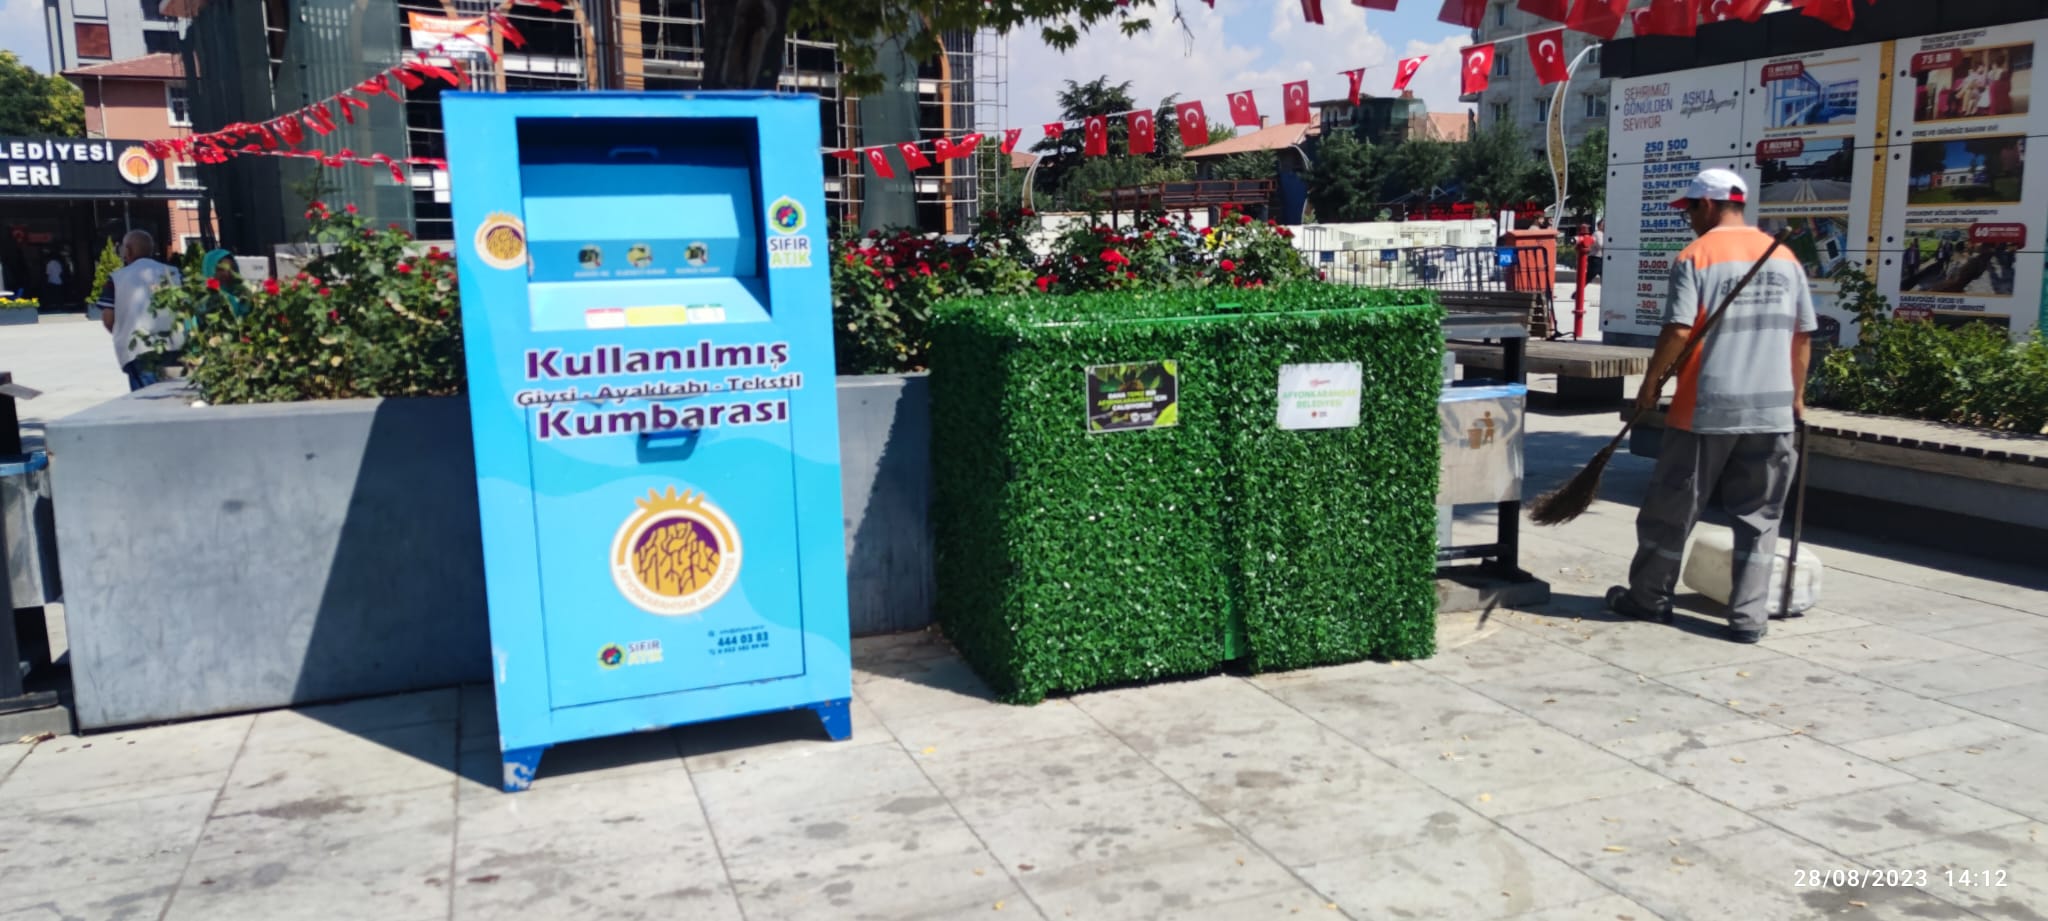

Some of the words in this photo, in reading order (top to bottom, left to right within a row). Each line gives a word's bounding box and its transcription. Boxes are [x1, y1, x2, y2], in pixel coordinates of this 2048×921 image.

[1922, 55, 1934, 64] 75
[1624, 99, 1673, 116] GÖNÜLDEN
[1645, 141, 1664, 153] 250
[1667, 138, 1688, 150] 500
[1671, 161, 1700, 172] METRE
[1671, 179, 1693, 188] MET
[769, 238, 809, 251] SIFIR
[770, 251, 810, 266] ATIK
[1638, 260, 1668, 269] 30.000
[1637, 283, 1653, 292] 190
[526, 341, 788, 379] Kullanılmış
[518, 388, 577, 409] Giysi
[598, 381, 709, 403] Ayakkabı
[726, 373, 801, 392] Tekstil
[538, 400, 788, 439] Kumbarası
[628, 639, 660, 653] SIFIR
[717, 636, 738, 648] 444
[740, 633, 753, 645] 03
[756, 631, 769, 642] 83
